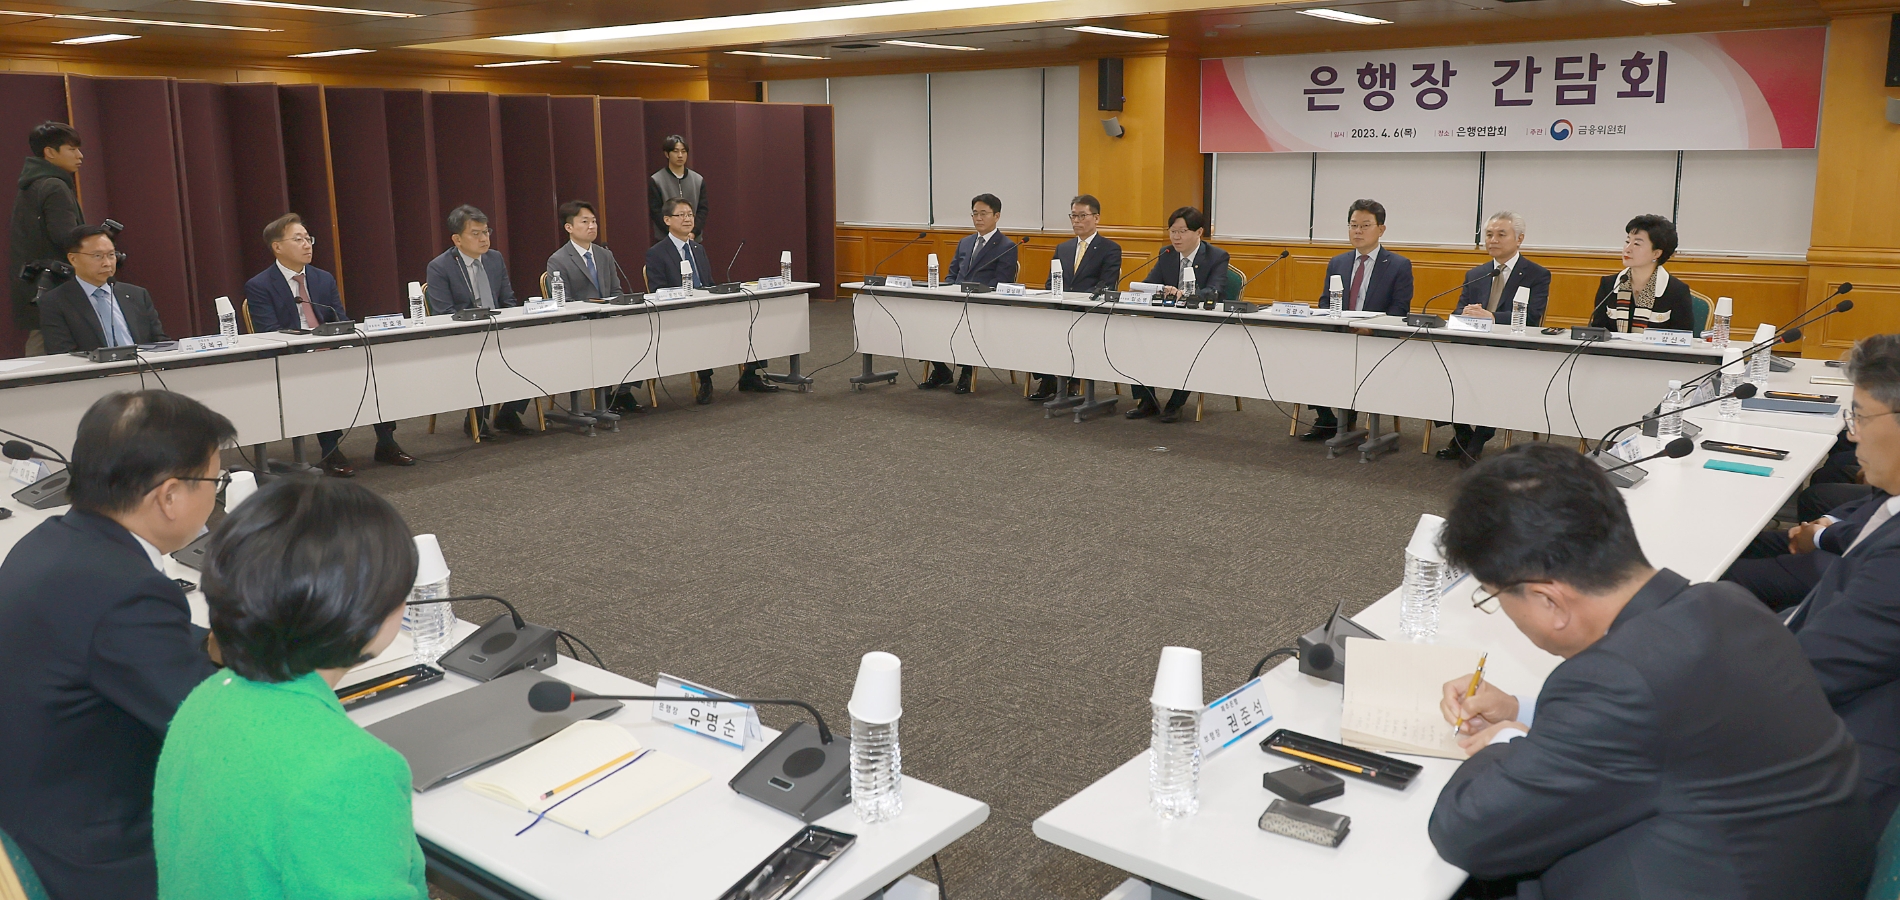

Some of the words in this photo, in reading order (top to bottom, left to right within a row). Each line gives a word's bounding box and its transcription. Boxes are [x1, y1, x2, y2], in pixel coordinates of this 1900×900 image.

[1303, 59, 1458, 112] 은행장
[1491, 50, 1668, 107] 간담회
[1351, 128, 1379, 138] 2023.
[1393, 127, 1417, 138] 6(목)
[1456, 126, 1507, 138] 은행연합회
[1529, 128, 1543, 136] 주관
[1578, 124, 1627, 135] 금융위원회
[658, 702, 679, 716] 은행장
[687, 707, 736, 739] 유명순
[1226, 698, 1265, 734] 권준석
